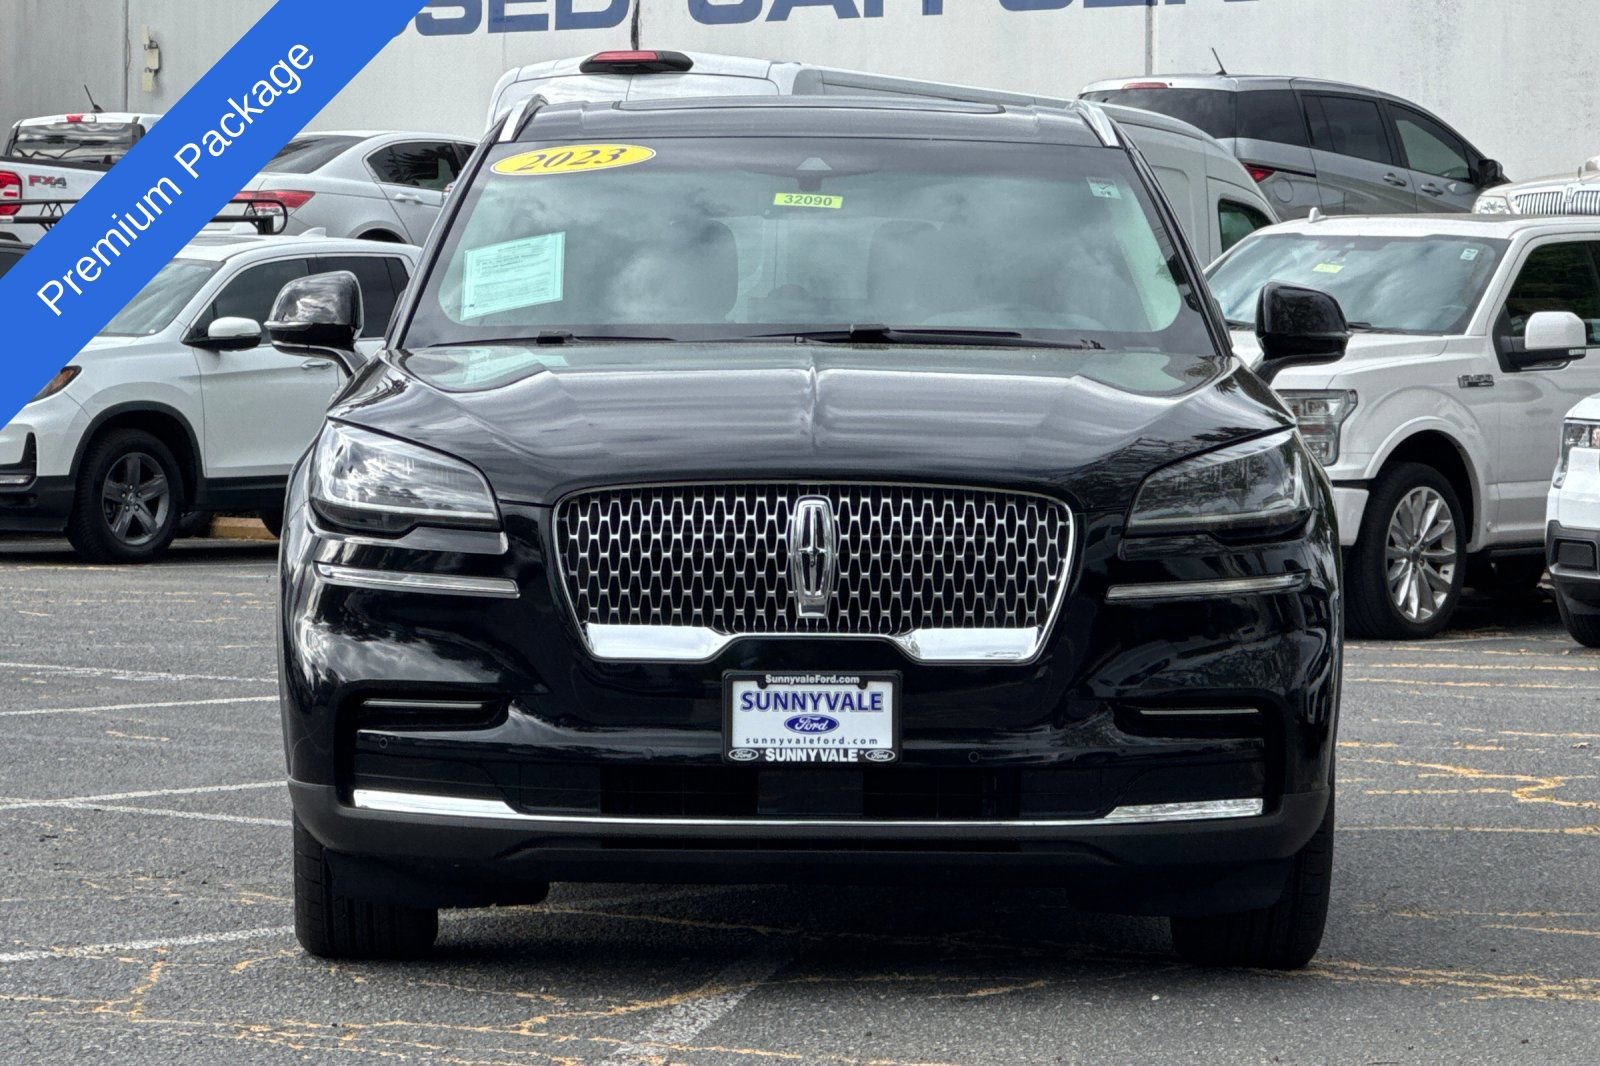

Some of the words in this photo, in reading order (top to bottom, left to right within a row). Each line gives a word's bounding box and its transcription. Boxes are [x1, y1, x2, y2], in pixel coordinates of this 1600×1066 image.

[514, 148, 627, 171] 2023
[28, 175, 67, 187] FX4
[783, 194, 833, 206] 32090
[765, 674, 860, 685] SunnyvaleFord.com
[741, 691, 883, 712] SUNNYVALE
[794, 715, 829, 731] Ford
[765, 748, 858, 762] SUNNYVALE
